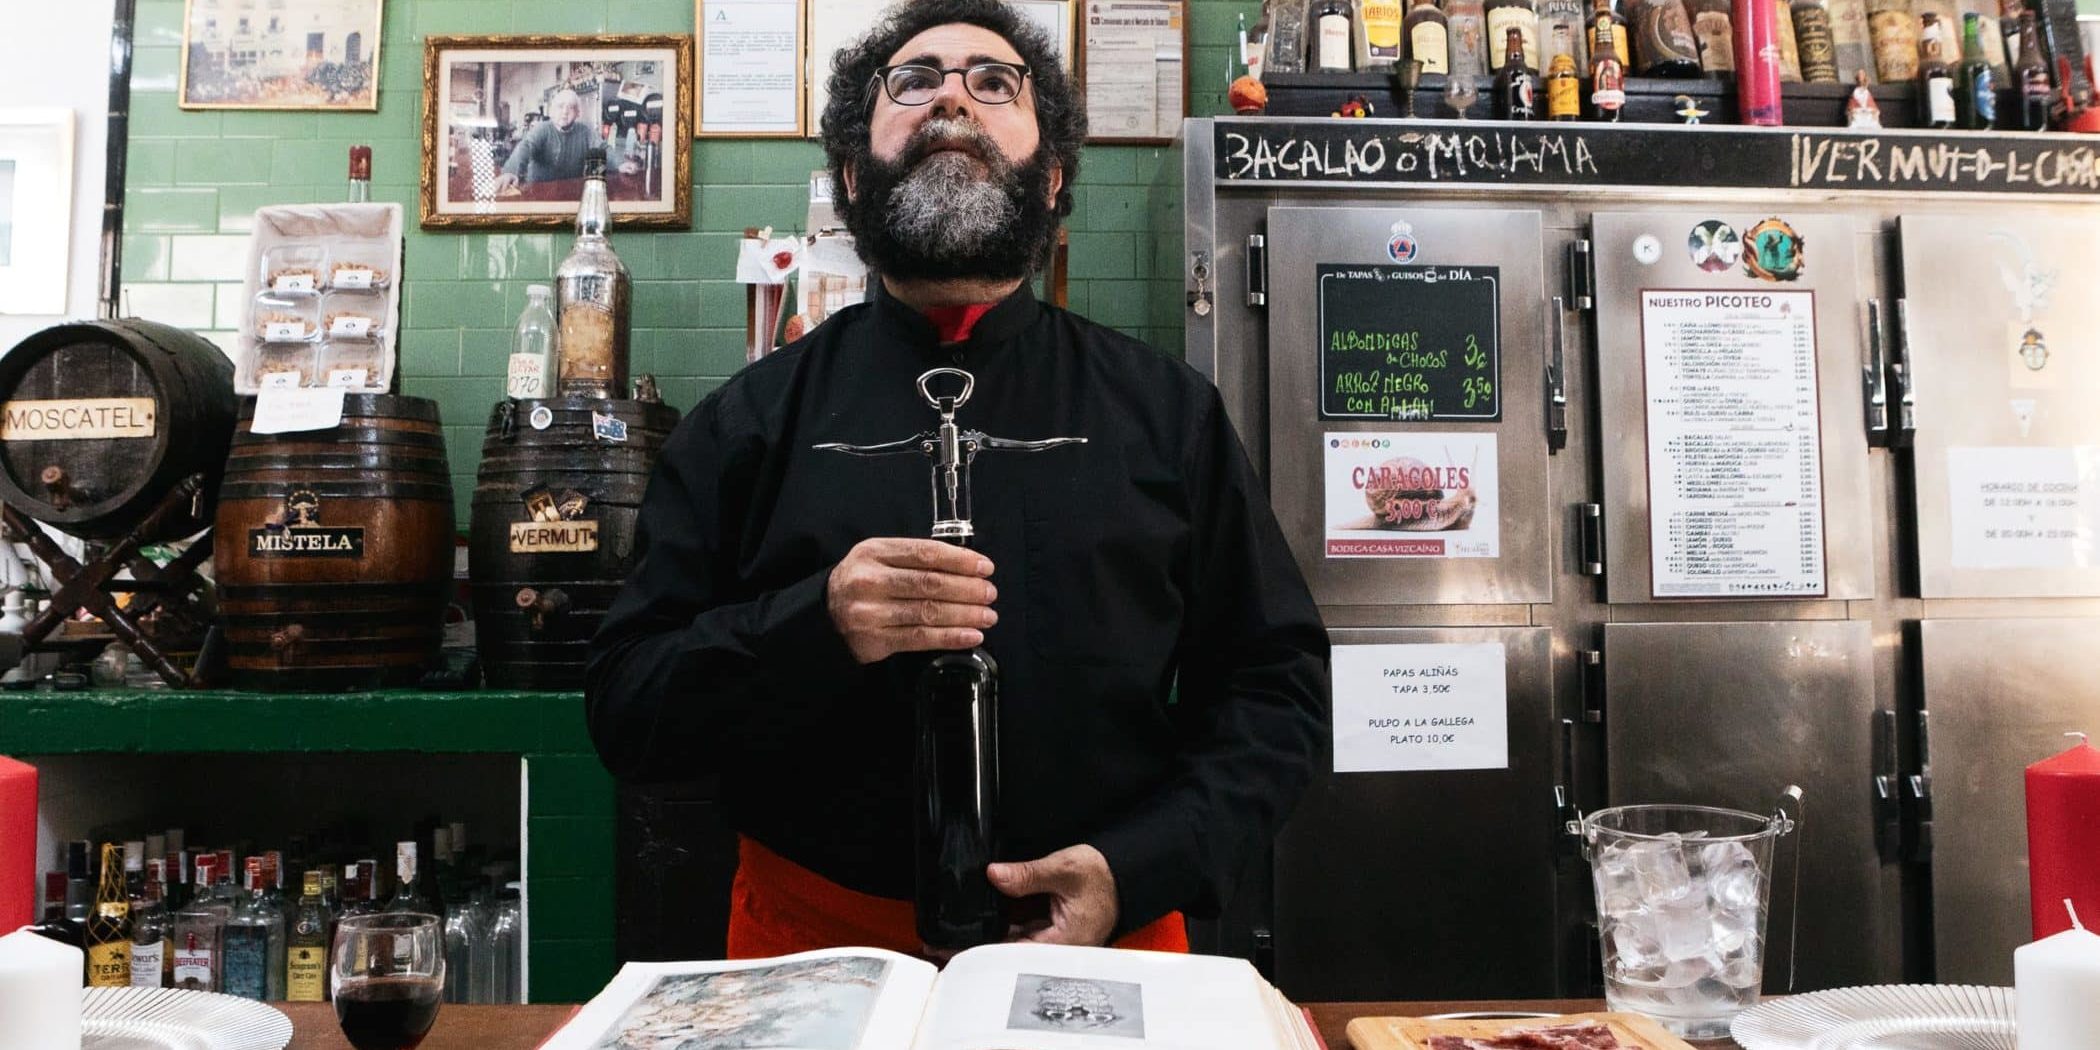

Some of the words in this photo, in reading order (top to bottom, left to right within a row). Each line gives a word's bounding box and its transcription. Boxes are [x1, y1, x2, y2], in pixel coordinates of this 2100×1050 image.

[1226, 132, 1385, 179] BACALAO
[1347, 271, 1373, 279] TAPAS
[1392, 272, 1424, 280] GUISOS
[1649, 298, 1702, 308] NUESTRO
[1705, 296, 1772, 308] PICOTEO
[1399, 350, 1448, 369] CHOCOS
[1384, 372, 1429, 394] NEGRO
[1347, 397, 1373, 413] CON
[6, 405, 145, 431] MOSCATEL
[1385, 499, 1423, 524] 3,00
[255, 534, 354, 551] MISTELA
[516, 528, 592, 546] VERMUT
[1331, 544, 1370, 554] BODEGA
[1370, 544, 1393, 554] CASA
[1393, 543, 1440, 554] VIZCAÍNO
[1383, 669, 1416, 678] PAPAS
[1420, 665, 1458, 677] ALIÑÁS
[1392, 686, 1418, 694] TAPA
[1422, 685, 1450, 694] 3,50€
[1368, 719, 1400, 728] PULPO
[1404, 718, 1411, 726] A
[1415, 718, 1428, 727] LA
[1431, 717, 1475, 726] GALLEGA
[1390, 735, 1423, 744] PLATO
[1427, 734, 1454, 744] 10,0€
